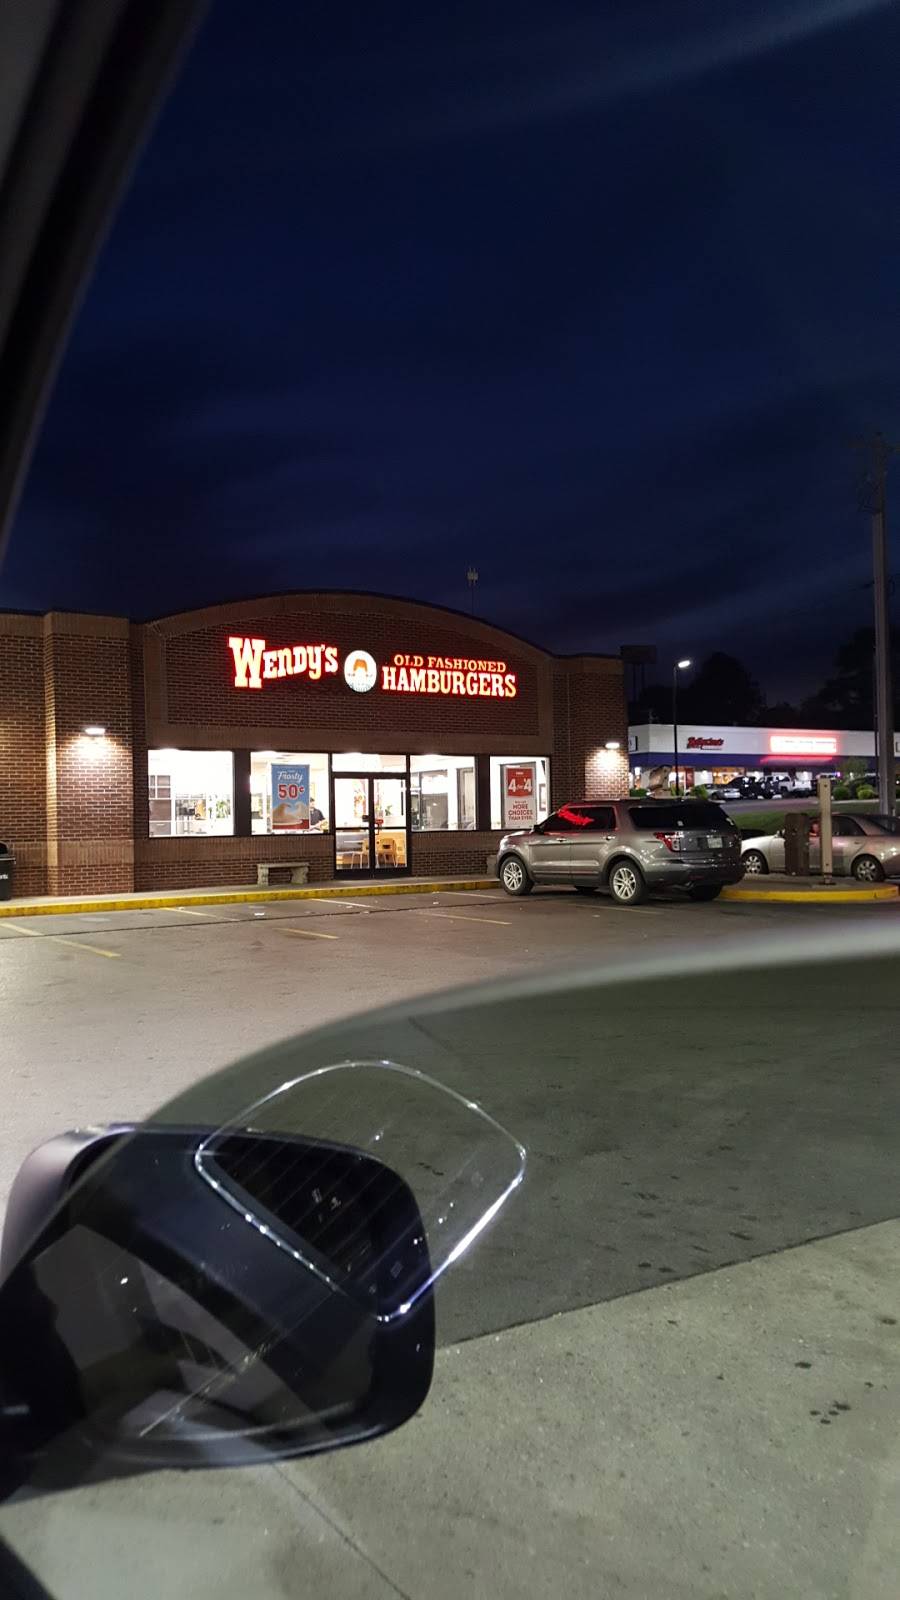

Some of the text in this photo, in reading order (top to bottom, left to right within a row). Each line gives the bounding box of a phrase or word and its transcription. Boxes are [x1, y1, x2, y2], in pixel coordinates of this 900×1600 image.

[394, 654, 506, 673] OLD FASHIONED
[382, 666, 517, 698] HAMBURGERS
[277, 770, 304, 783] Frosty
[508, 778, 517, 793] 4
